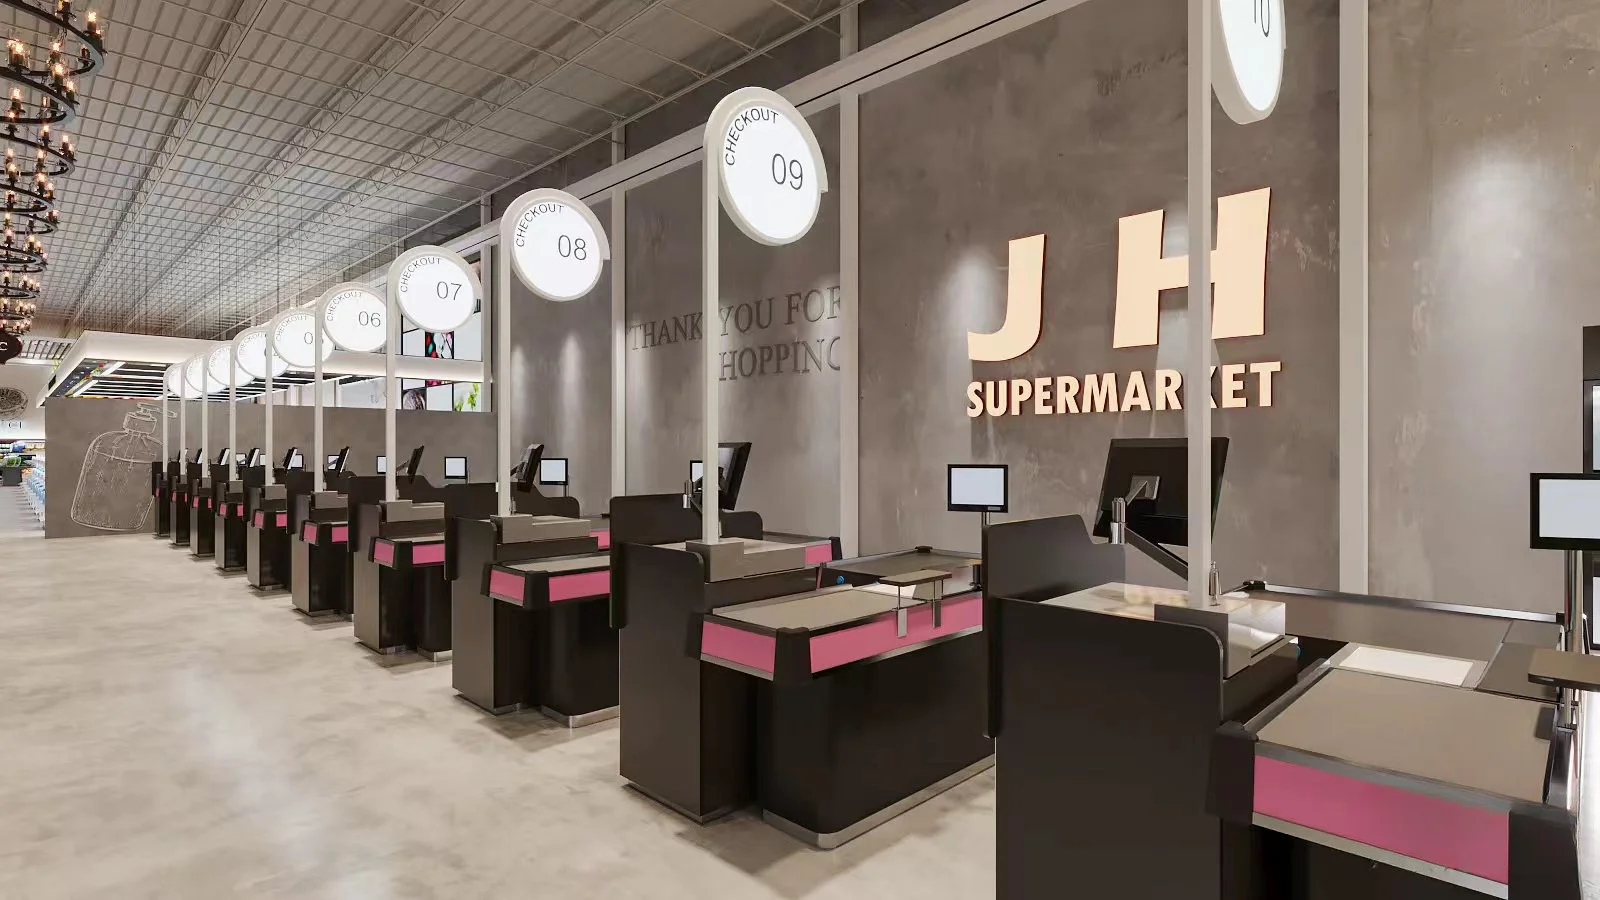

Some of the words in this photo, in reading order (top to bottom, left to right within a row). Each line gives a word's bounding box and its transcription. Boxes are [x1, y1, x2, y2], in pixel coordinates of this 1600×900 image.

[724, 107, 779, 166] CHECKOUT
[771, 153, 804, 191] 09
[515, 203, 564, 248] CHECKOUT
[557, 234, 587, 261] 08
[400, 256, 442, 293] CHECKOUT
[436, 280, 463, 301] 07
[326, 291, 363, 322] CHECKOUT
[358, 310, 382, 328] 06
[626, 312, 703, 351] THANK
[718, 297, 776, 337] YOU
[718, 336, 841, 381] HOPPIN
[966, 361, 1282, 418] SUPERMARET
